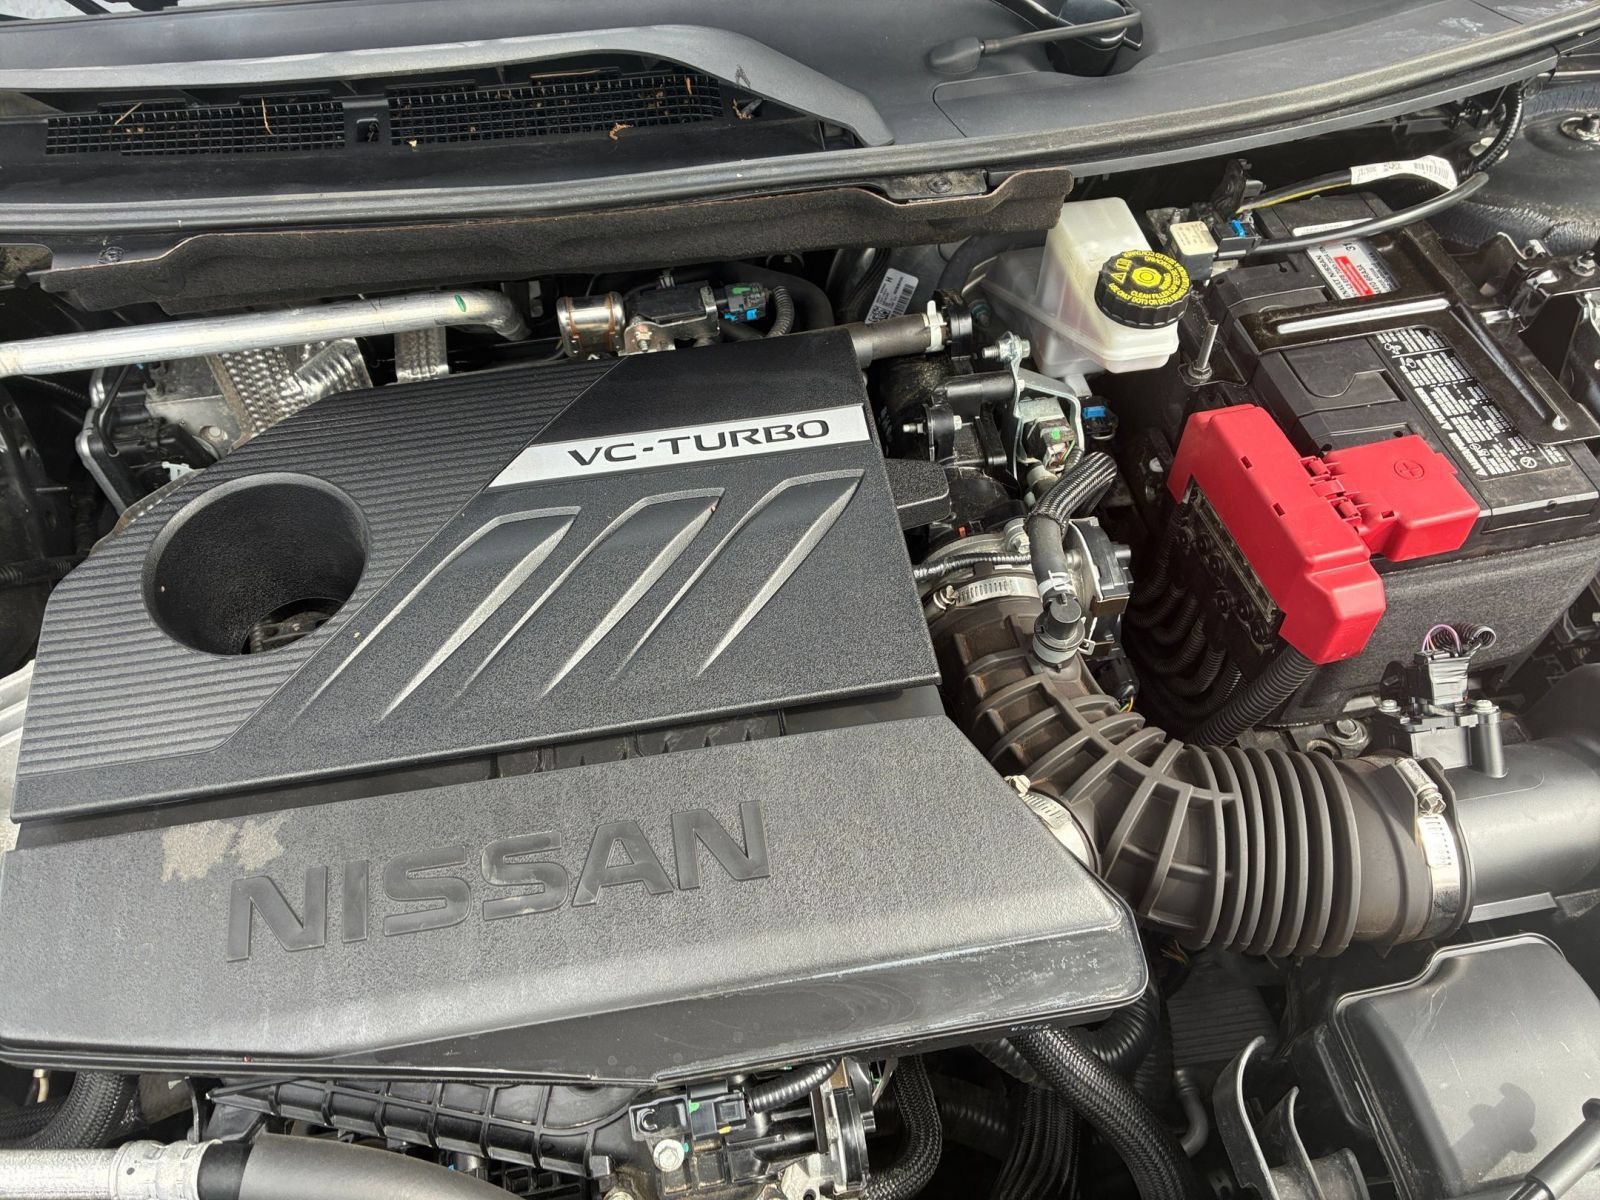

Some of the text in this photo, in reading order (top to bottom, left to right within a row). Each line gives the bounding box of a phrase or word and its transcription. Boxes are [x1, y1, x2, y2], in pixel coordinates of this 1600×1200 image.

[1315, 255, 1336, 278] NISSAN
[1117, 291, 1132, 300] ONLY
[568, 419, 829, 466] VC-TURBO
[226, 803, 770, 962] NISSAN
